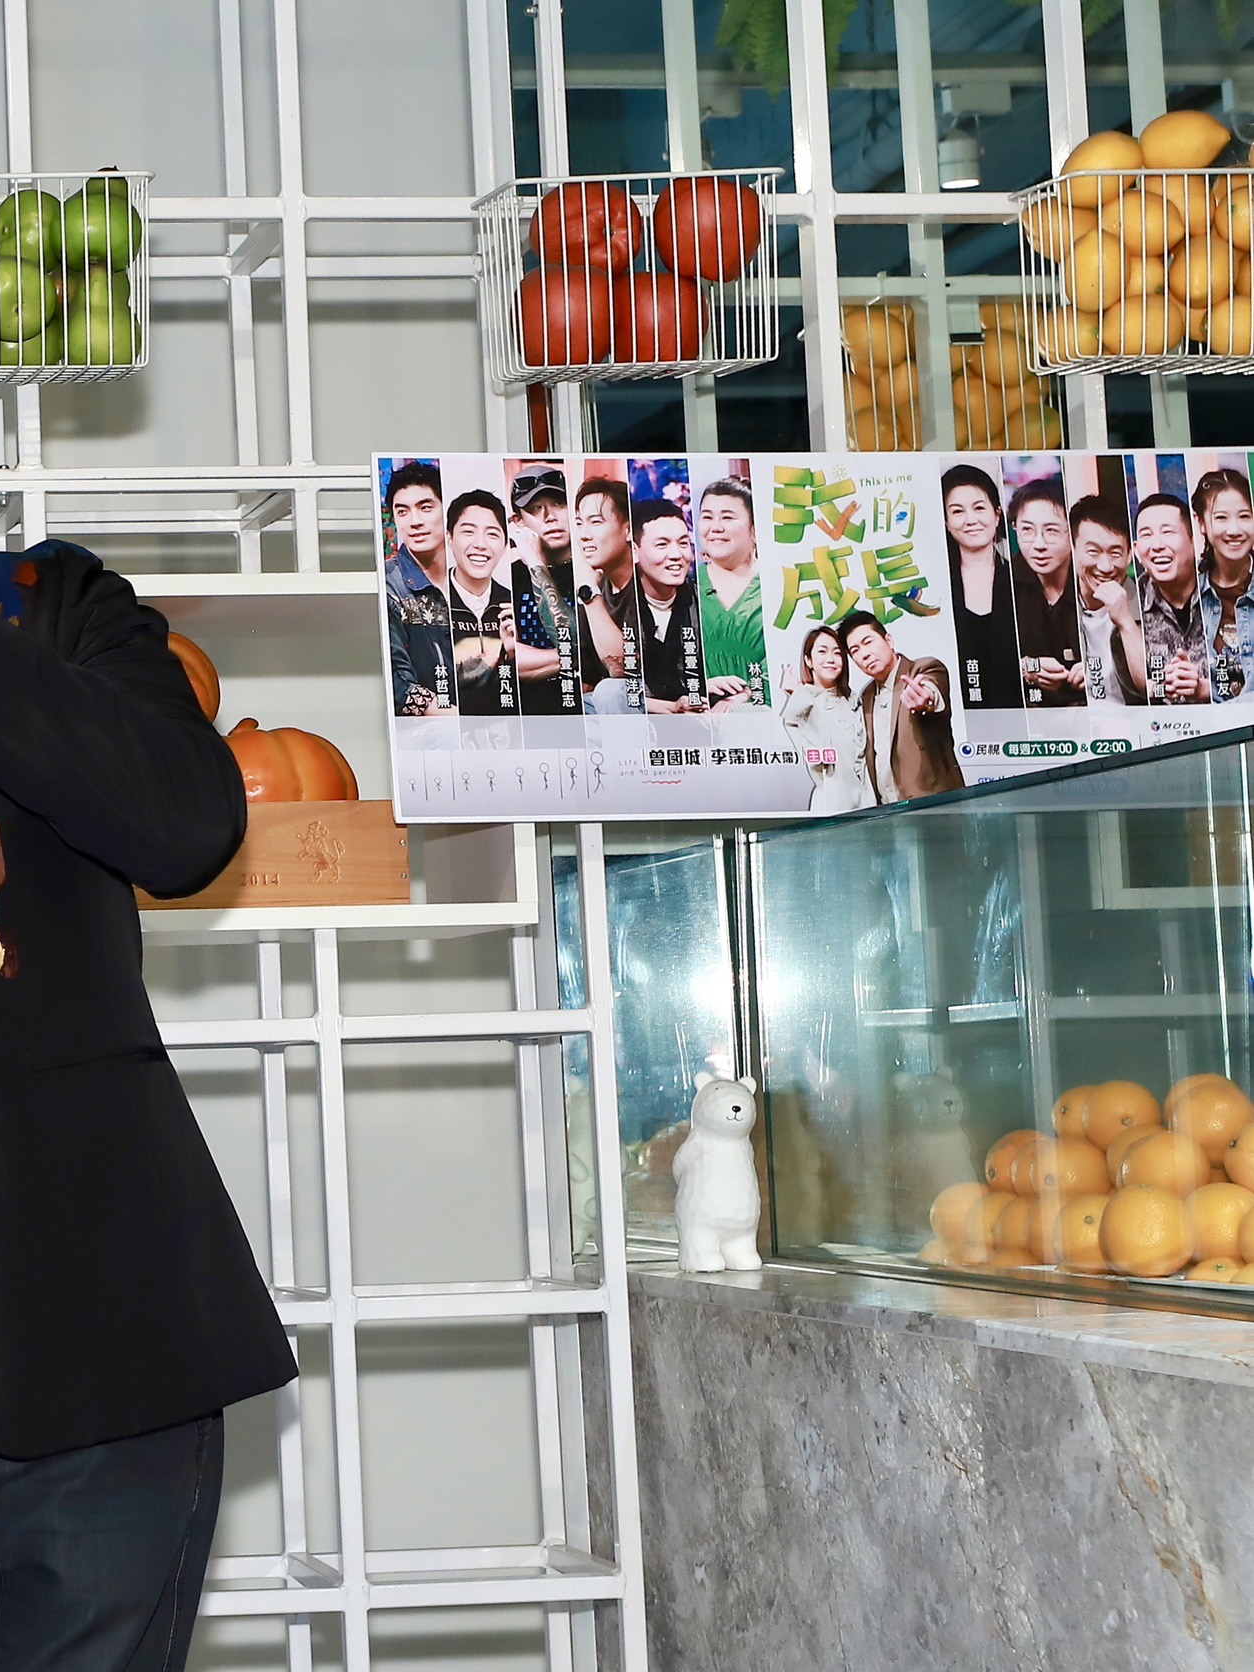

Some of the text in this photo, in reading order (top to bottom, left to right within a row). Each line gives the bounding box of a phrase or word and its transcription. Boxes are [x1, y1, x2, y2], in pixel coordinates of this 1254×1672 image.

[859, 474, 913, 488] This is me
[772, 465, 916, 544] 我的
[772, 541, 940, 630] 成長
[1215, 653, 1230, 696] 方志友
[748, 662, 765, 705] 林美秀
[1162, 722, 1191, 730] MOD
[976, 744, 1000, 756] 民視
[1080, 743, 1088, 753] &
[1096, 741, 1126, 754] 22:00
[649, 749, 701, 766] 曾國城
[808, 750, 837, 763] 主持
[240, 874, 281, 887] 2014
